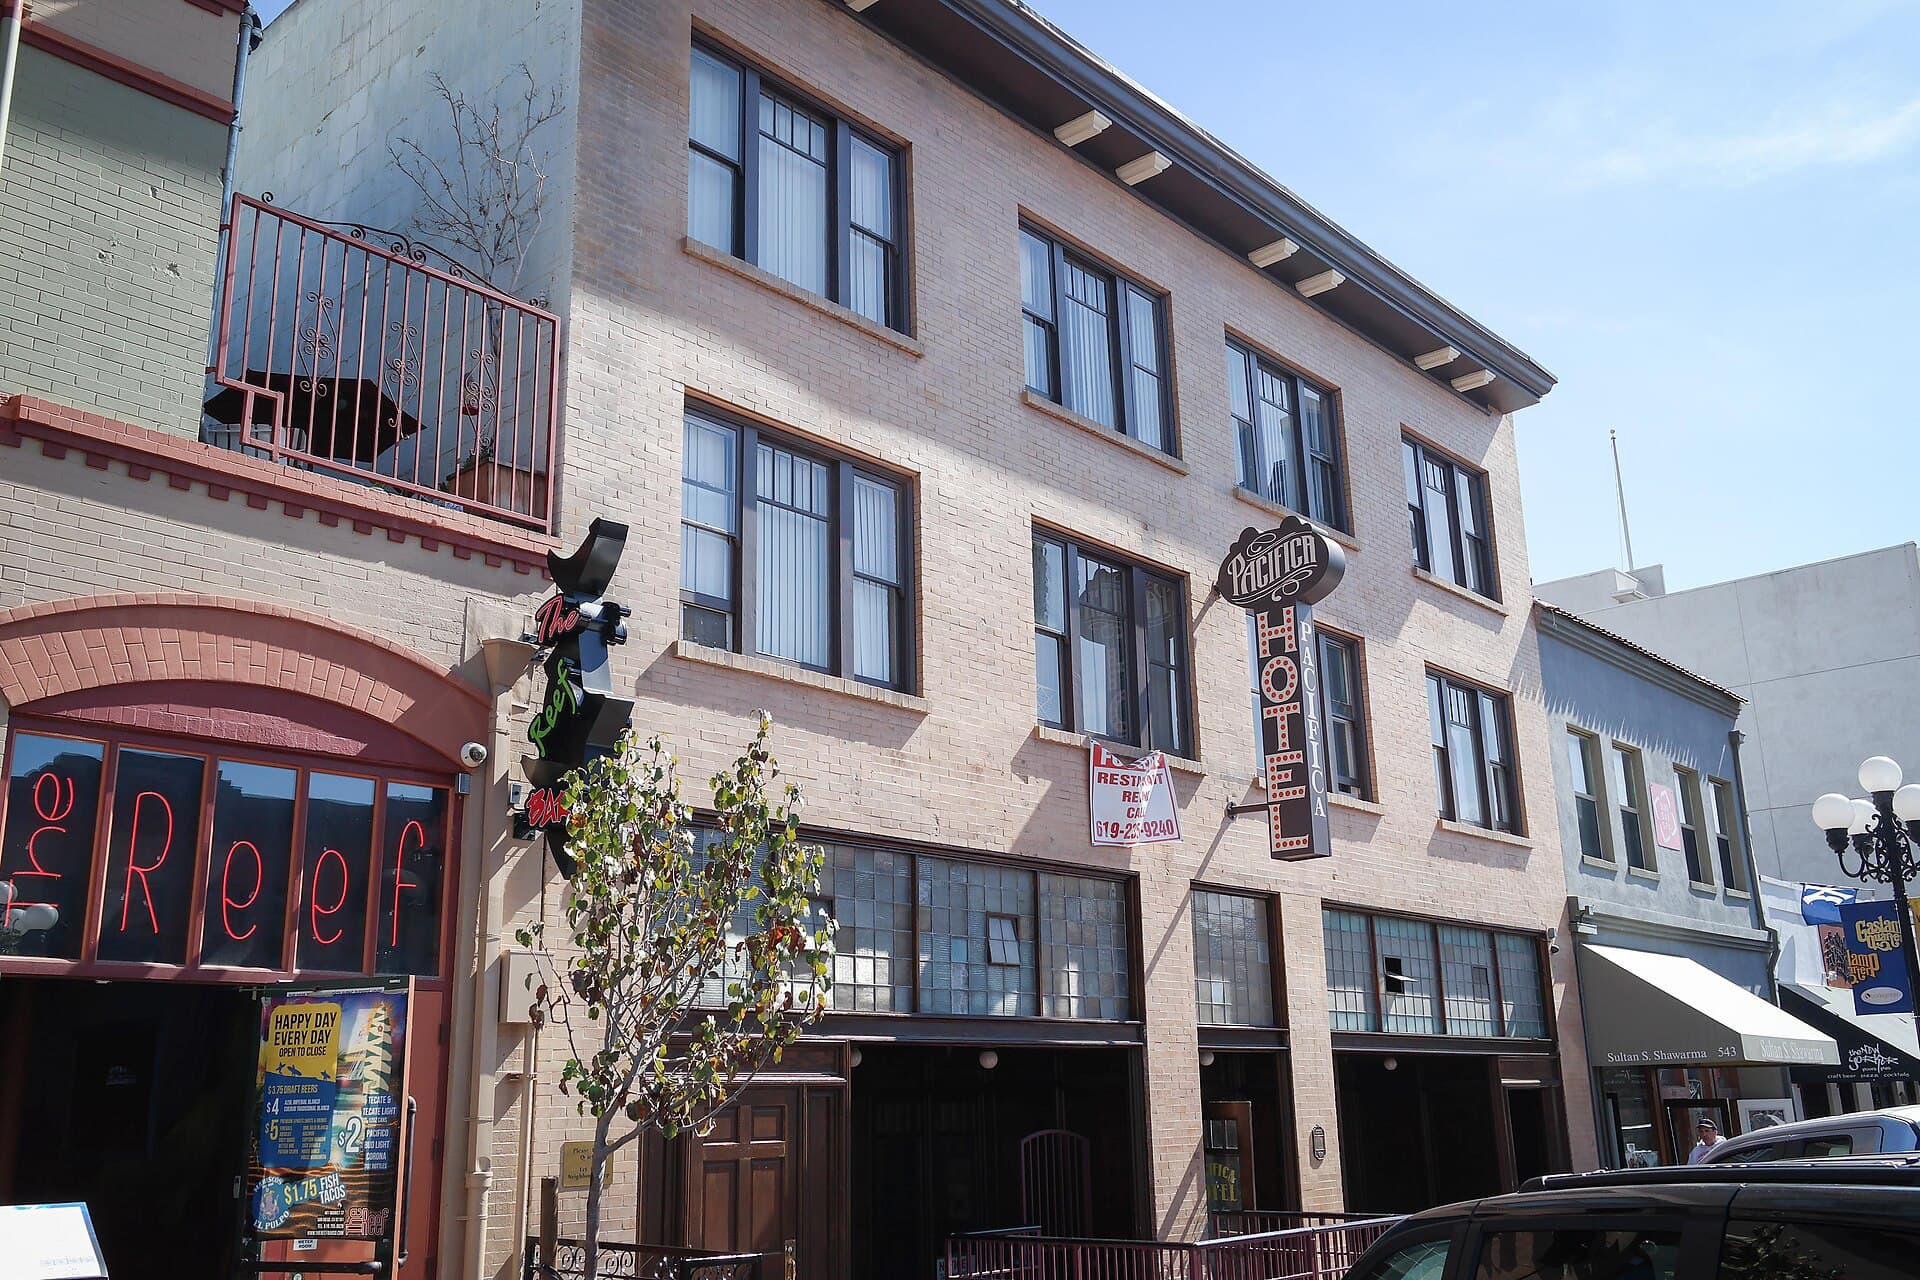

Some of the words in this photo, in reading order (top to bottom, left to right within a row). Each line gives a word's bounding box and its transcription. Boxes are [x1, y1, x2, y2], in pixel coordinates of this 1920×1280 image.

[1228, 535, 1318, 598] PACIFICA
[538, 597, 578, 643] The
[531, 658, 577, 758] Reef
[1300, 621, 1327, 818] PACIFICA
[1256, 606, 1309, 852] HOTEL
[121, 791, 424, 947] Reef
[275, 1013, 312, 1030] HAPPY
[315, 1012, 337, 1028] DAY
[274, 1030, 308, 1045] EVERY
[310, 1029, 332, 1044] DAY
[279, 1047, 296, 1057] OPEN
[297, 1047, 306, 1057] TO
[306, 1046, 327, 1056] CLOSE
[1607, 1052, 1640, 1063] Sultan
[1641, 1051, 1651, 1061] S.
[1653, 1049, 1708, 1061] Shawarma
[1718, 1047, 1737, 1058] 543
[283, 1085, 300, 1094] DRAFT
[301, 1084, 318, 1093] BEERS
[266, 1098, 279, 1115] $4
[368, 1095, 386, 1104] TECATE
[363, 1107, 381, 1116] TECATE
[382, 1106, 397, 1115] LIGHT
[264, 1119, 279, 1141] $5
[338, 1116, 362, 1153] $2
[366, 1129, 389, 1138] PACIFICO
[375, 1140, 390, 1149] LIGHT
[366, 1152, 387, 1160] CORONA
[319, 1173, 340, 1190] FISH
[284, 1178, 317, 1205] $1.75
[318, 1184, 346, 1204] TACOS
[265, 1210, 290, 1230] PULPO
